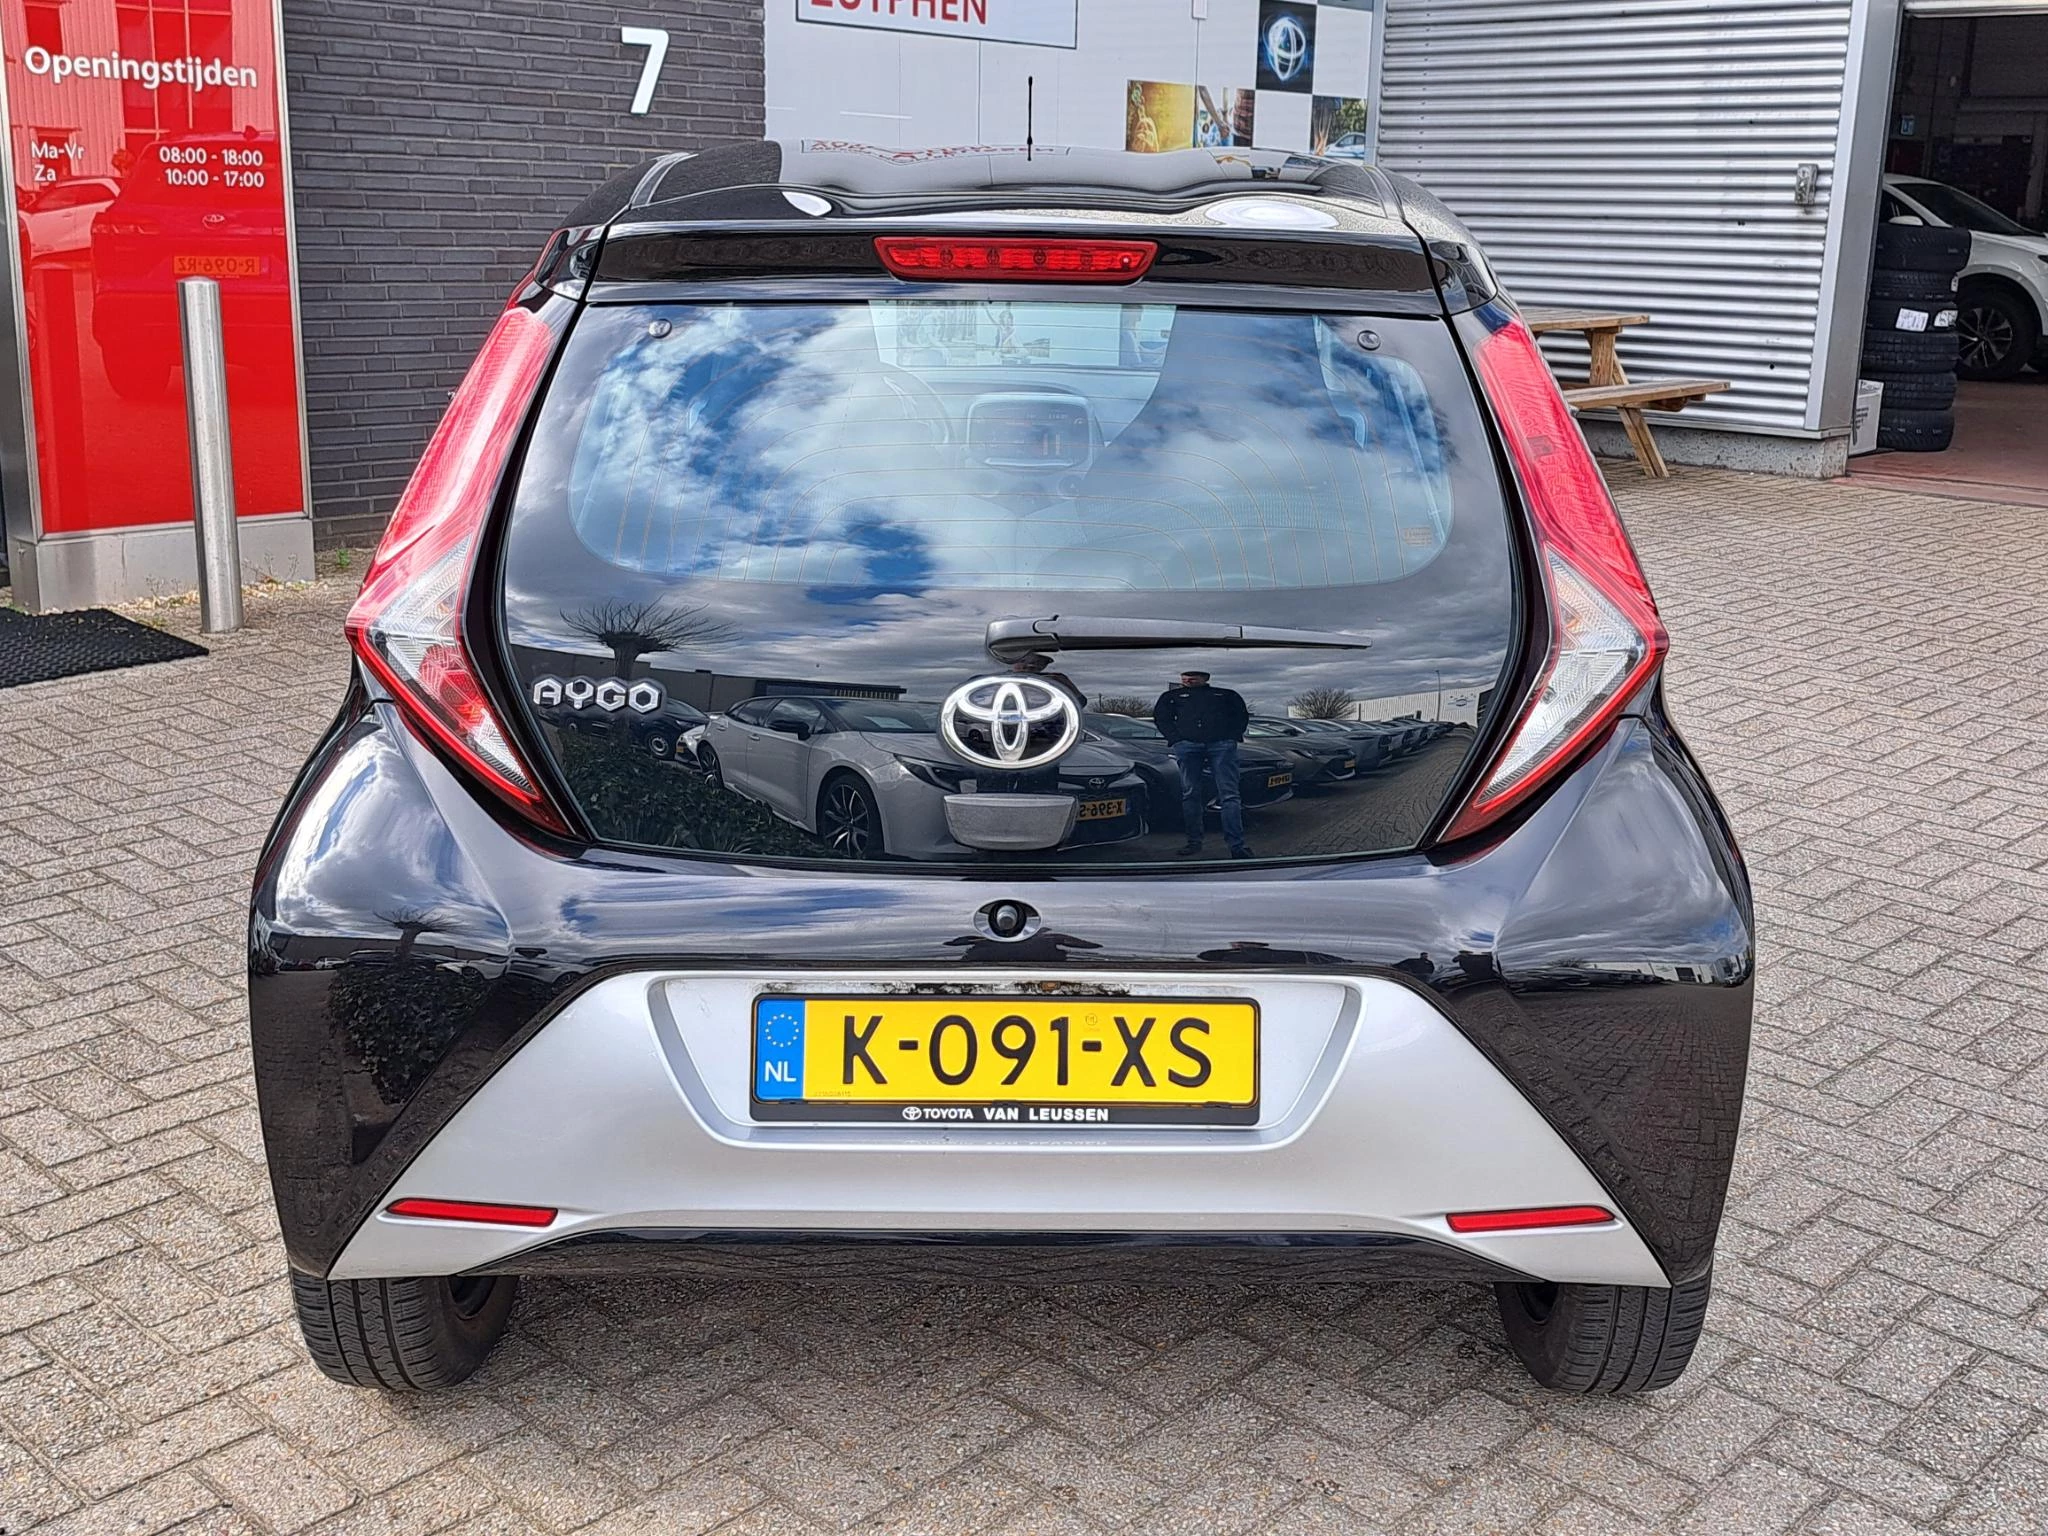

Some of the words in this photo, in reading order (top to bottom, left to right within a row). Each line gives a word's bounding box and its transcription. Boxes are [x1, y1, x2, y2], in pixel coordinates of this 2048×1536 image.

[24, 46, 258, 91] Openingstijden
[621, 26, 669, 114] 7
[30, 141, 84, 160] Ma-Vr
[159, 147, 207, 164] 08:00
[221, 149, 263, 166] 18:00
[34, 164, 56, 182] Za
[165, 169, 209, 186] 10:00
[223, 172, 264, 188] 17:00
[533, 678, 660, 714] AYGO
[842, 1014, 1212, 1088] K-091-XS
[764, 1060, 797, 1083] NL
[923, 1107, 974, 1120] TOYOTA
[983, 1107, 1019, 1120] VAN
[1028, 1108, 1109, 1121] LEUSSEN
